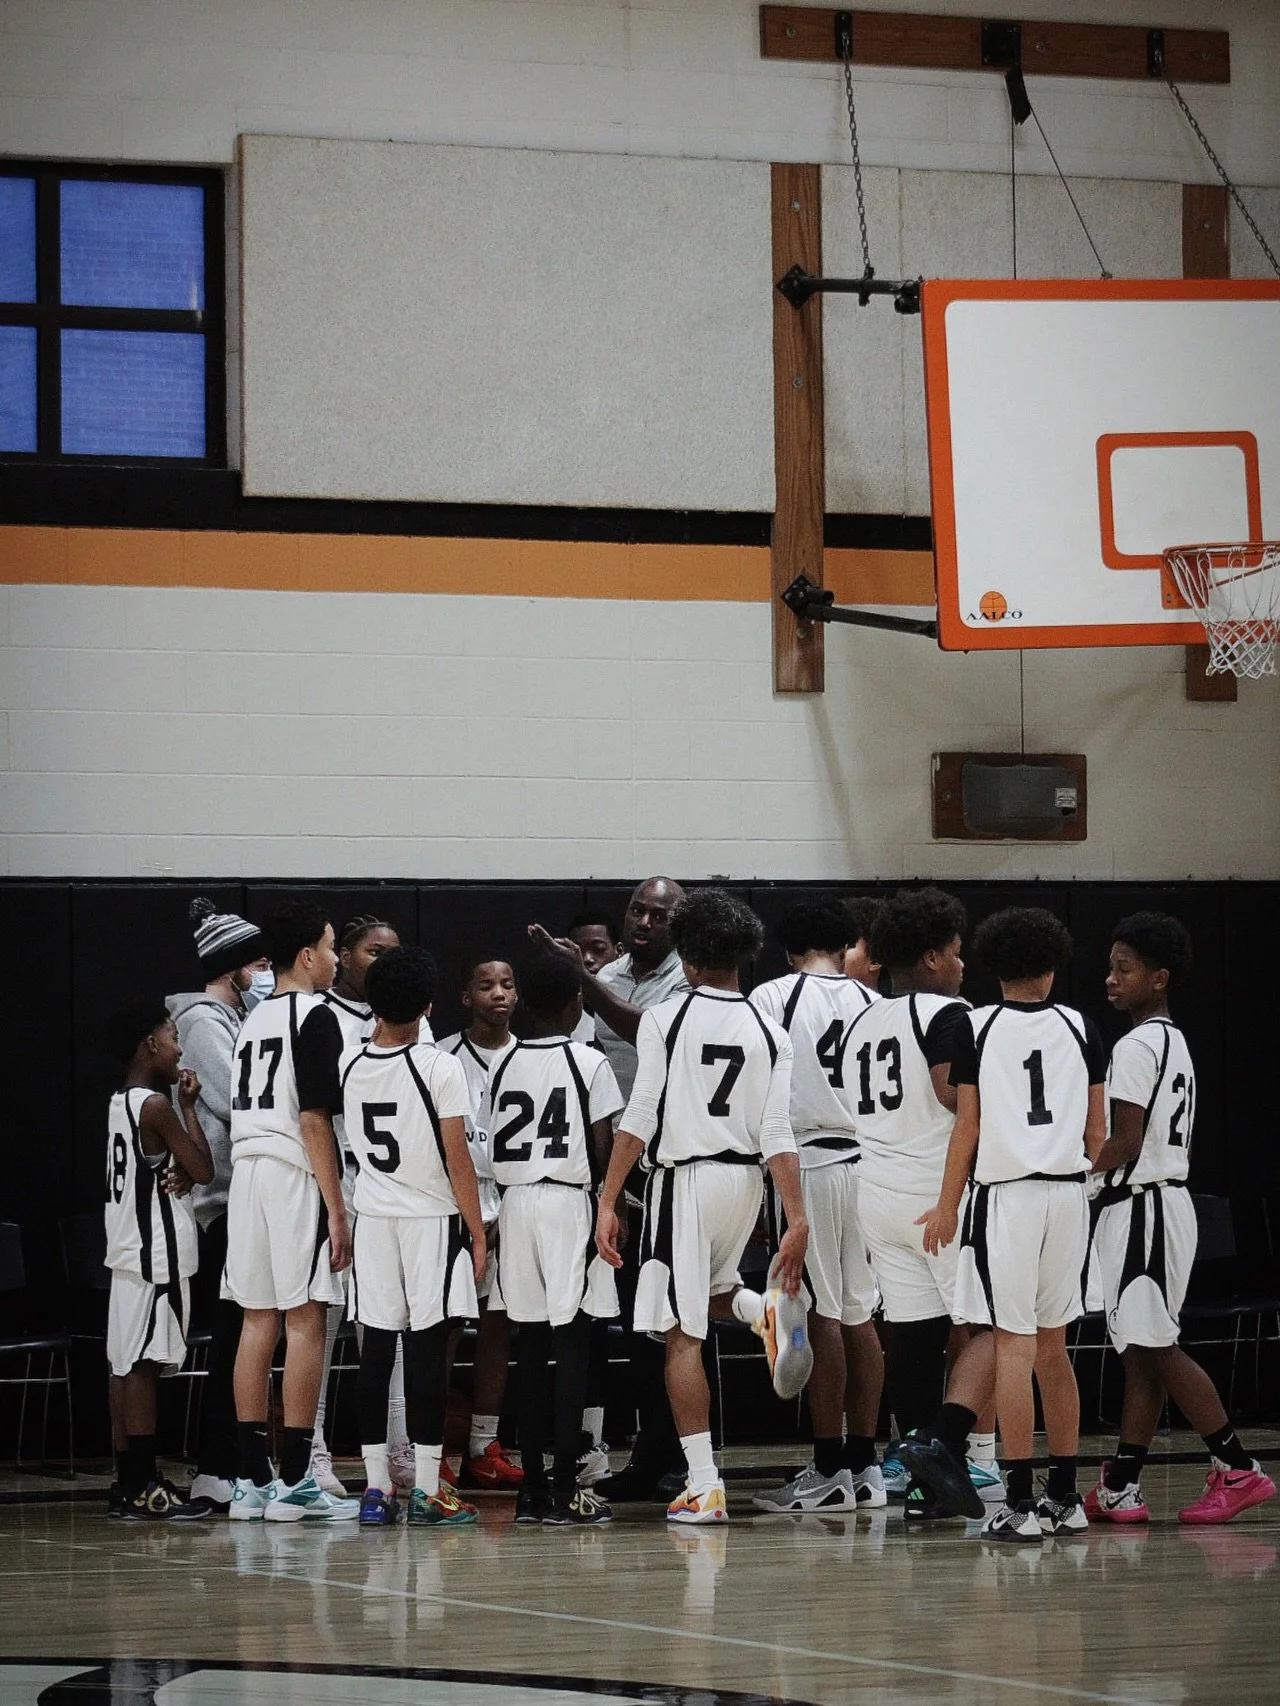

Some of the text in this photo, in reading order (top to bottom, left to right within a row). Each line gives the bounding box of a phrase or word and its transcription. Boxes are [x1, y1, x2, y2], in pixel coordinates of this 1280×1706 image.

[966, 610, 1023, 620] AALCO
[233, 1037, 283, 1110] 17
[702, 1043, 745, 1117] 7
[856, 1036, 903, 1115] 13
[1023, 1049, 1053, 1126] 1
[362, 1102, 401, 1173] 5
[493, 1087, 570, 1162] 24
